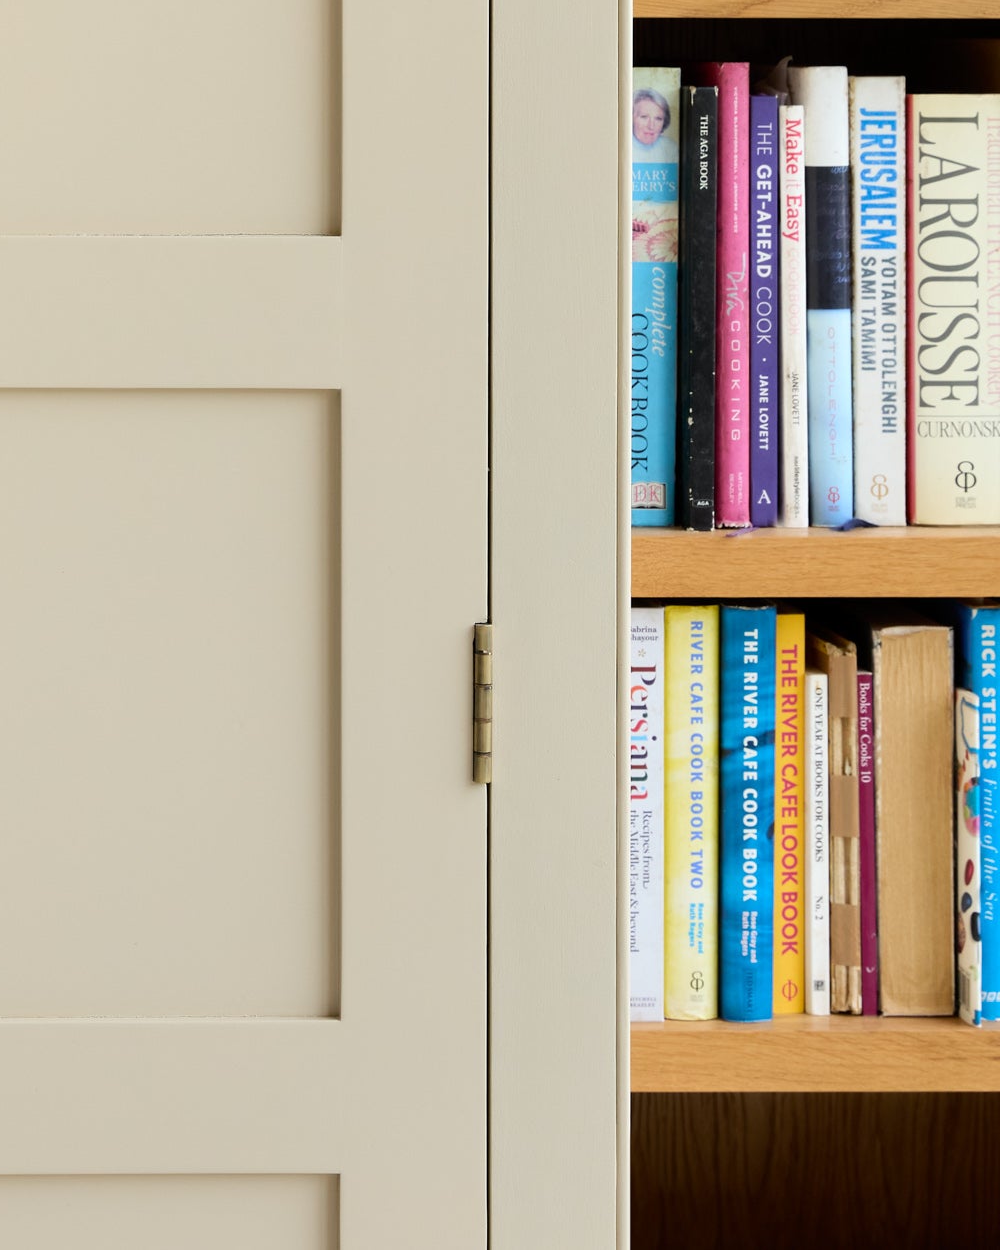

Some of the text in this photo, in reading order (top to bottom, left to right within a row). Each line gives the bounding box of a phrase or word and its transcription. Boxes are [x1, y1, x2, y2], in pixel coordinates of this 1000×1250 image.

[700, 115, 709, 190] THE AGA BOOK
[785, 119, 803, 174] Make
[632, 169, 668, 180] MARY
[632, 181, 676, 191] ERRY'S
[787, 178, 800, 190] it
[860, 108, 897, 250] JERUSALEM
[782, 194, 803, 242] Easy
[756, 123, 772, 451] THE GET-AHEAD COOK JANE LOVETT
[917, 111, 981, 409] LAROUSSE
[645, 266, 672, 358] complete
[861, 256, 876, 372] SAMI TAMIMI
[881, 256, 898, 434] YOTAM OTTOLENGHI
[730, 320, 741, 441] COOKING
[791, 372, 800, 426] JANE LOVETT
[827, 327, 837, 461] OTTOLENGHI
[633, 486, 662, 503] DK
[631, 634, 659, 642] hayour
[815, 687, 823, 712] ONE
[631, 664, 657, 801] Persiana
[815, 714, 823, 741] YEAR
[815, 742, 823, 758] AT
[859, 682, 872, 783] Books for Cooks 10
[690, 621, 704, 889] RIVER CAFE COOK BOOK TWO
[742, 629, 758, 902] THE RIVER CAFE COOK BOOK
[815, 760, 824, 798] BOOKS
[980, 624, 998, 921] RICK STEIN'S Fruits of the Sea
[781, 644, 798, 955] THE RIVER CAFE LOOK BOOK
[815, 800, 824, 821] FOR
[640, 810, 654, 889] Recipes from
[815, 824, 824, 863] COOKS
[630, 872, 639, 897] East
[630, 911, 640, 953] beyond
[740, 930, 749, 956] Rogers
[750, 930, 758, 949] Gray
